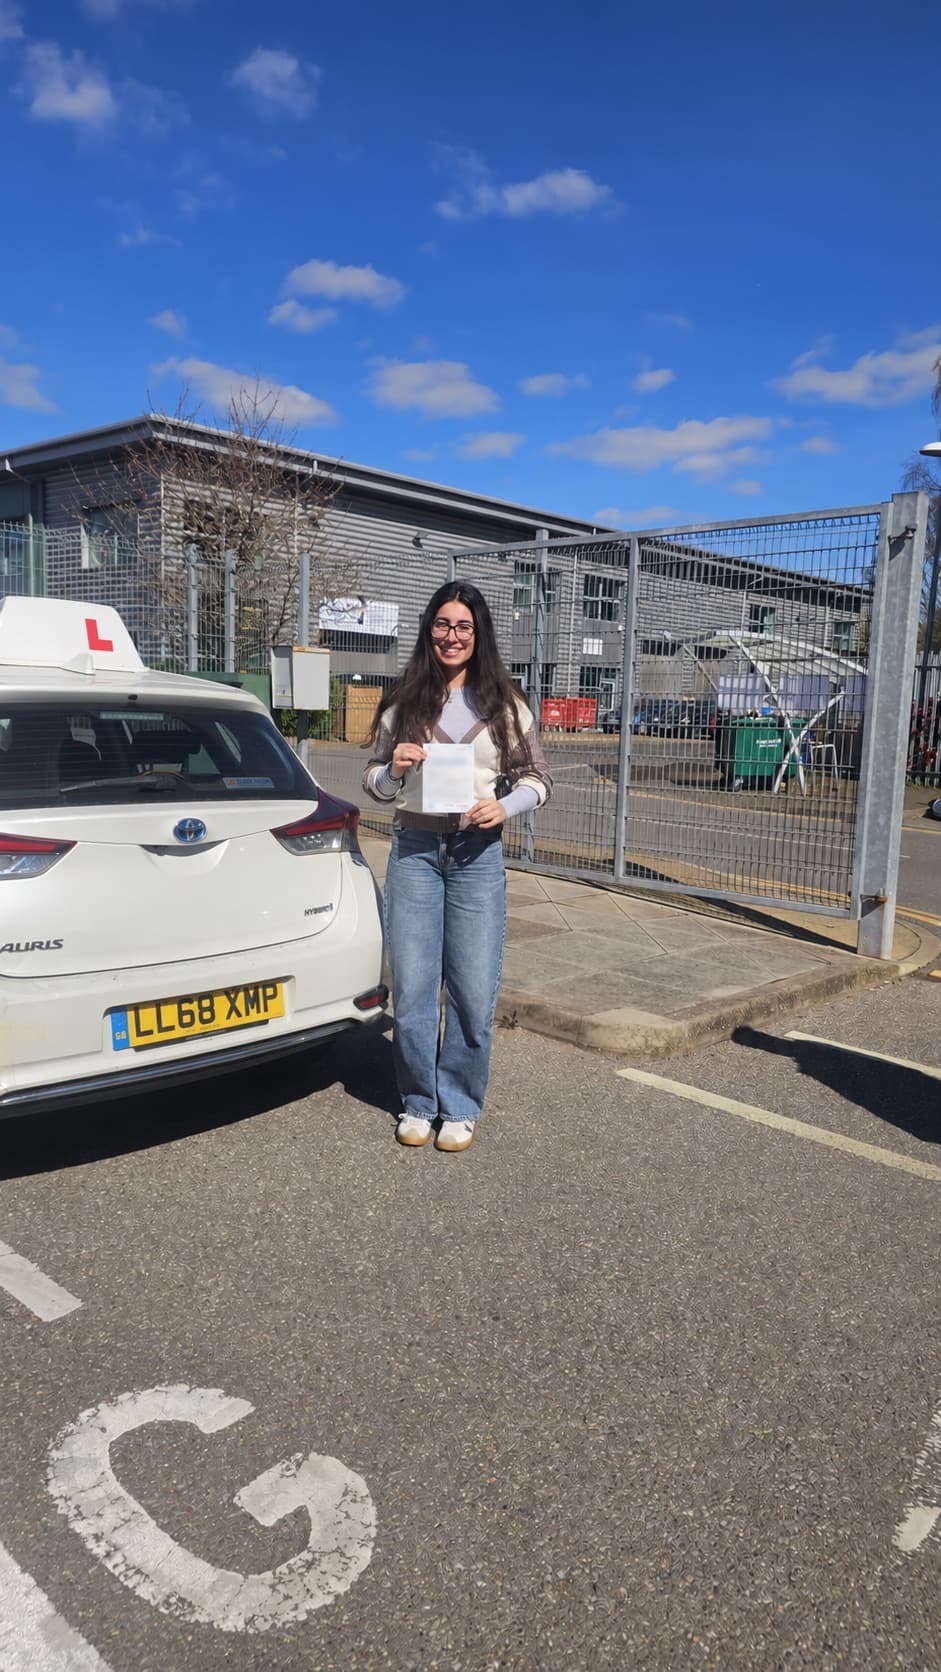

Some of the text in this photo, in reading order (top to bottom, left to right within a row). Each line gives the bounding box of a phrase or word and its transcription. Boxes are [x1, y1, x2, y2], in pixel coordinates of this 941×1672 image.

[85, 618, 113, 652] L
[0, 938, 64, 953] AURIS
[134, 983, 278, 1037] LL68 XMP
[47, 1384, 377, 1632] G
